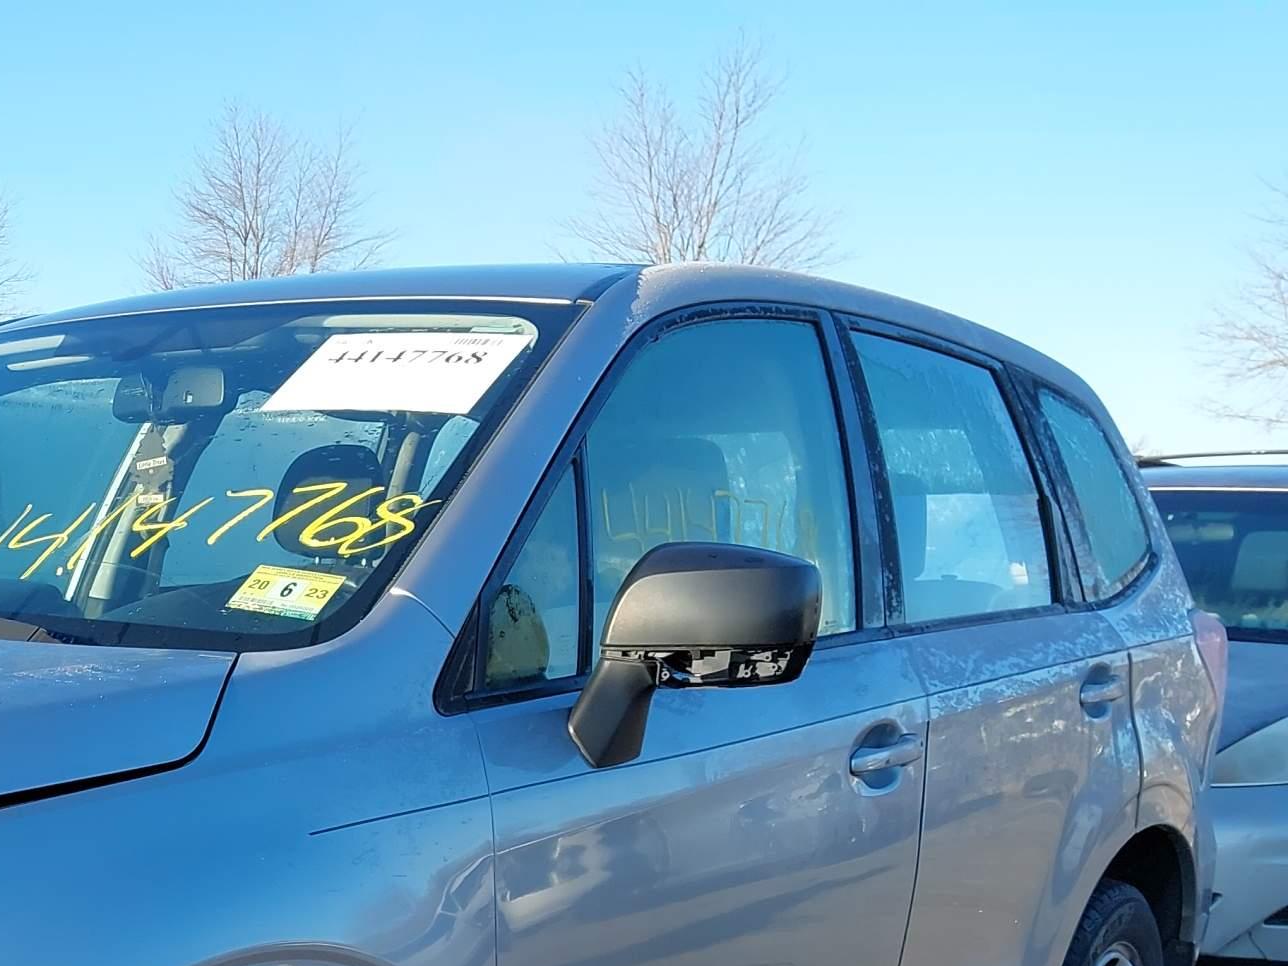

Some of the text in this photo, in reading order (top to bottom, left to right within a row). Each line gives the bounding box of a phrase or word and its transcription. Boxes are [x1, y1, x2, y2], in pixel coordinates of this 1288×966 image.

[327, 349, 489, 366] 44147768
[247, 579, 330, 601] 20 6 23
